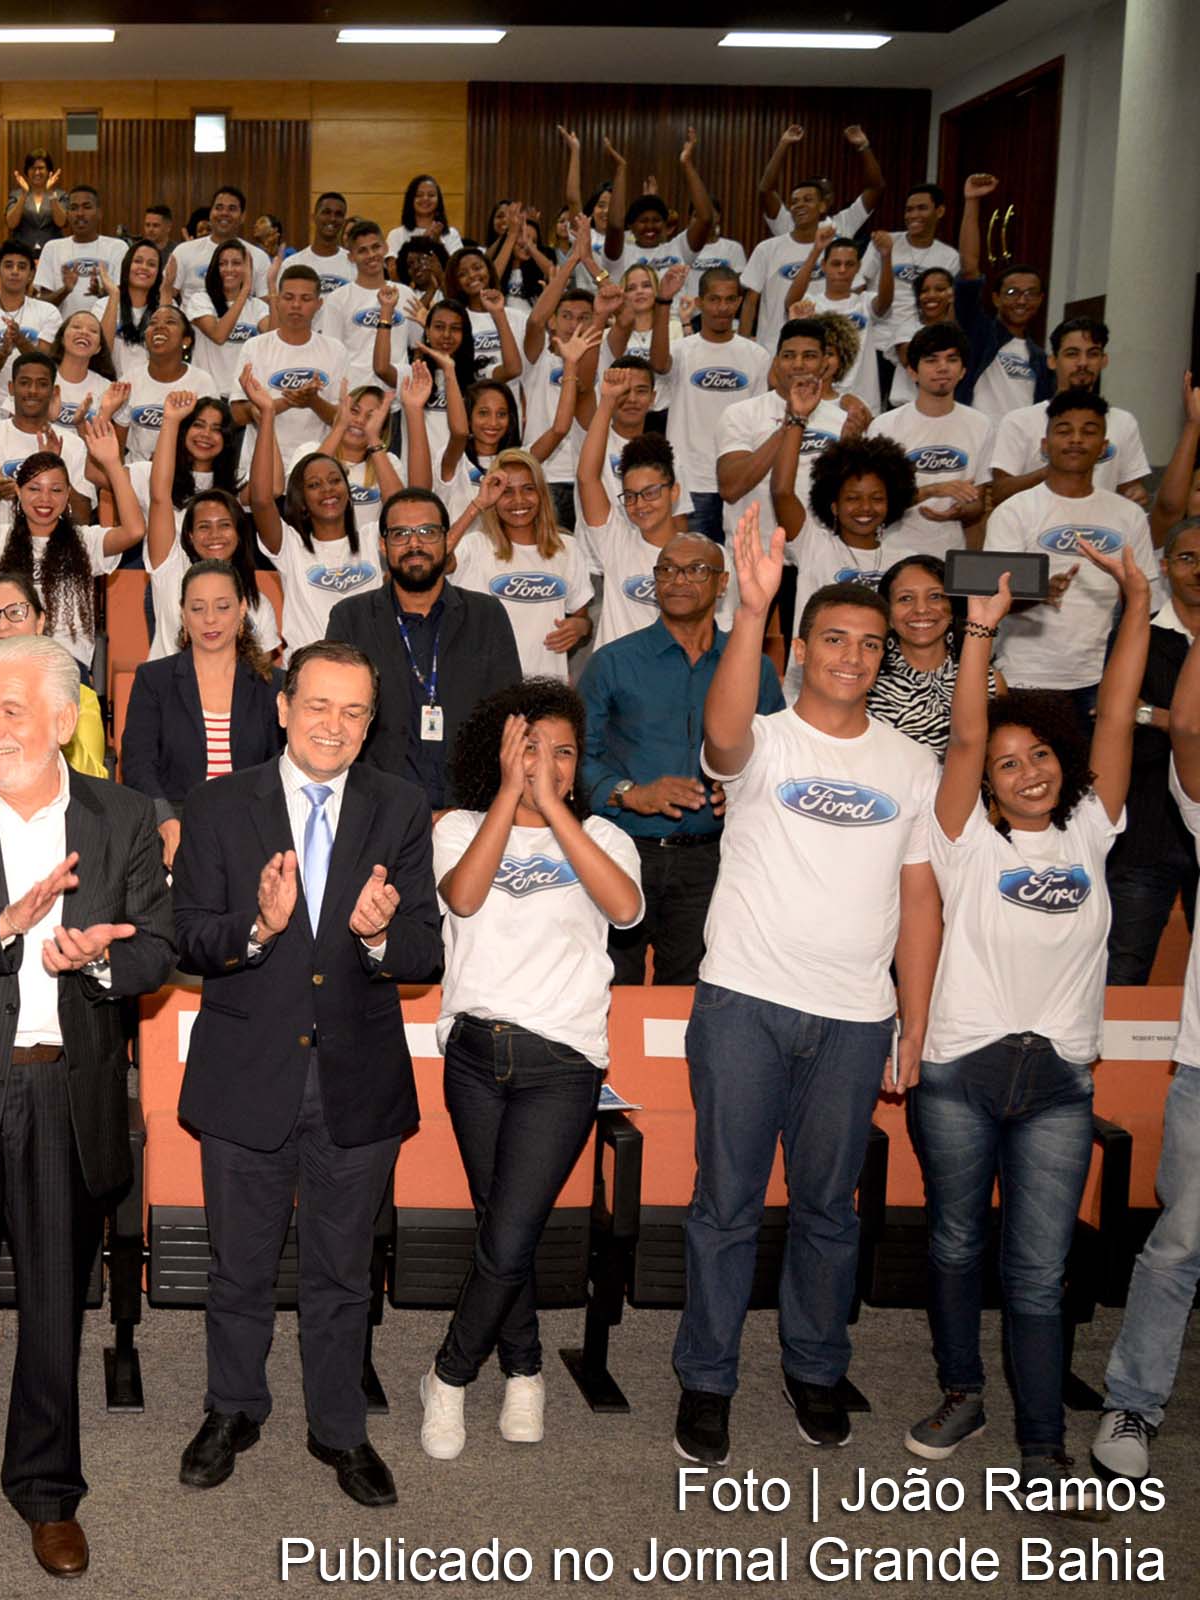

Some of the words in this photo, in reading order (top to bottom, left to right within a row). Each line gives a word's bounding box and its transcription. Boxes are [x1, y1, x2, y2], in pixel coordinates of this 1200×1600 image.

[916, 451, 958, 469] Ford
[504, 576, 555, 597] Ford
[799, 782, 875, 820] Ford
[495, 860, 559, 889] Ford
